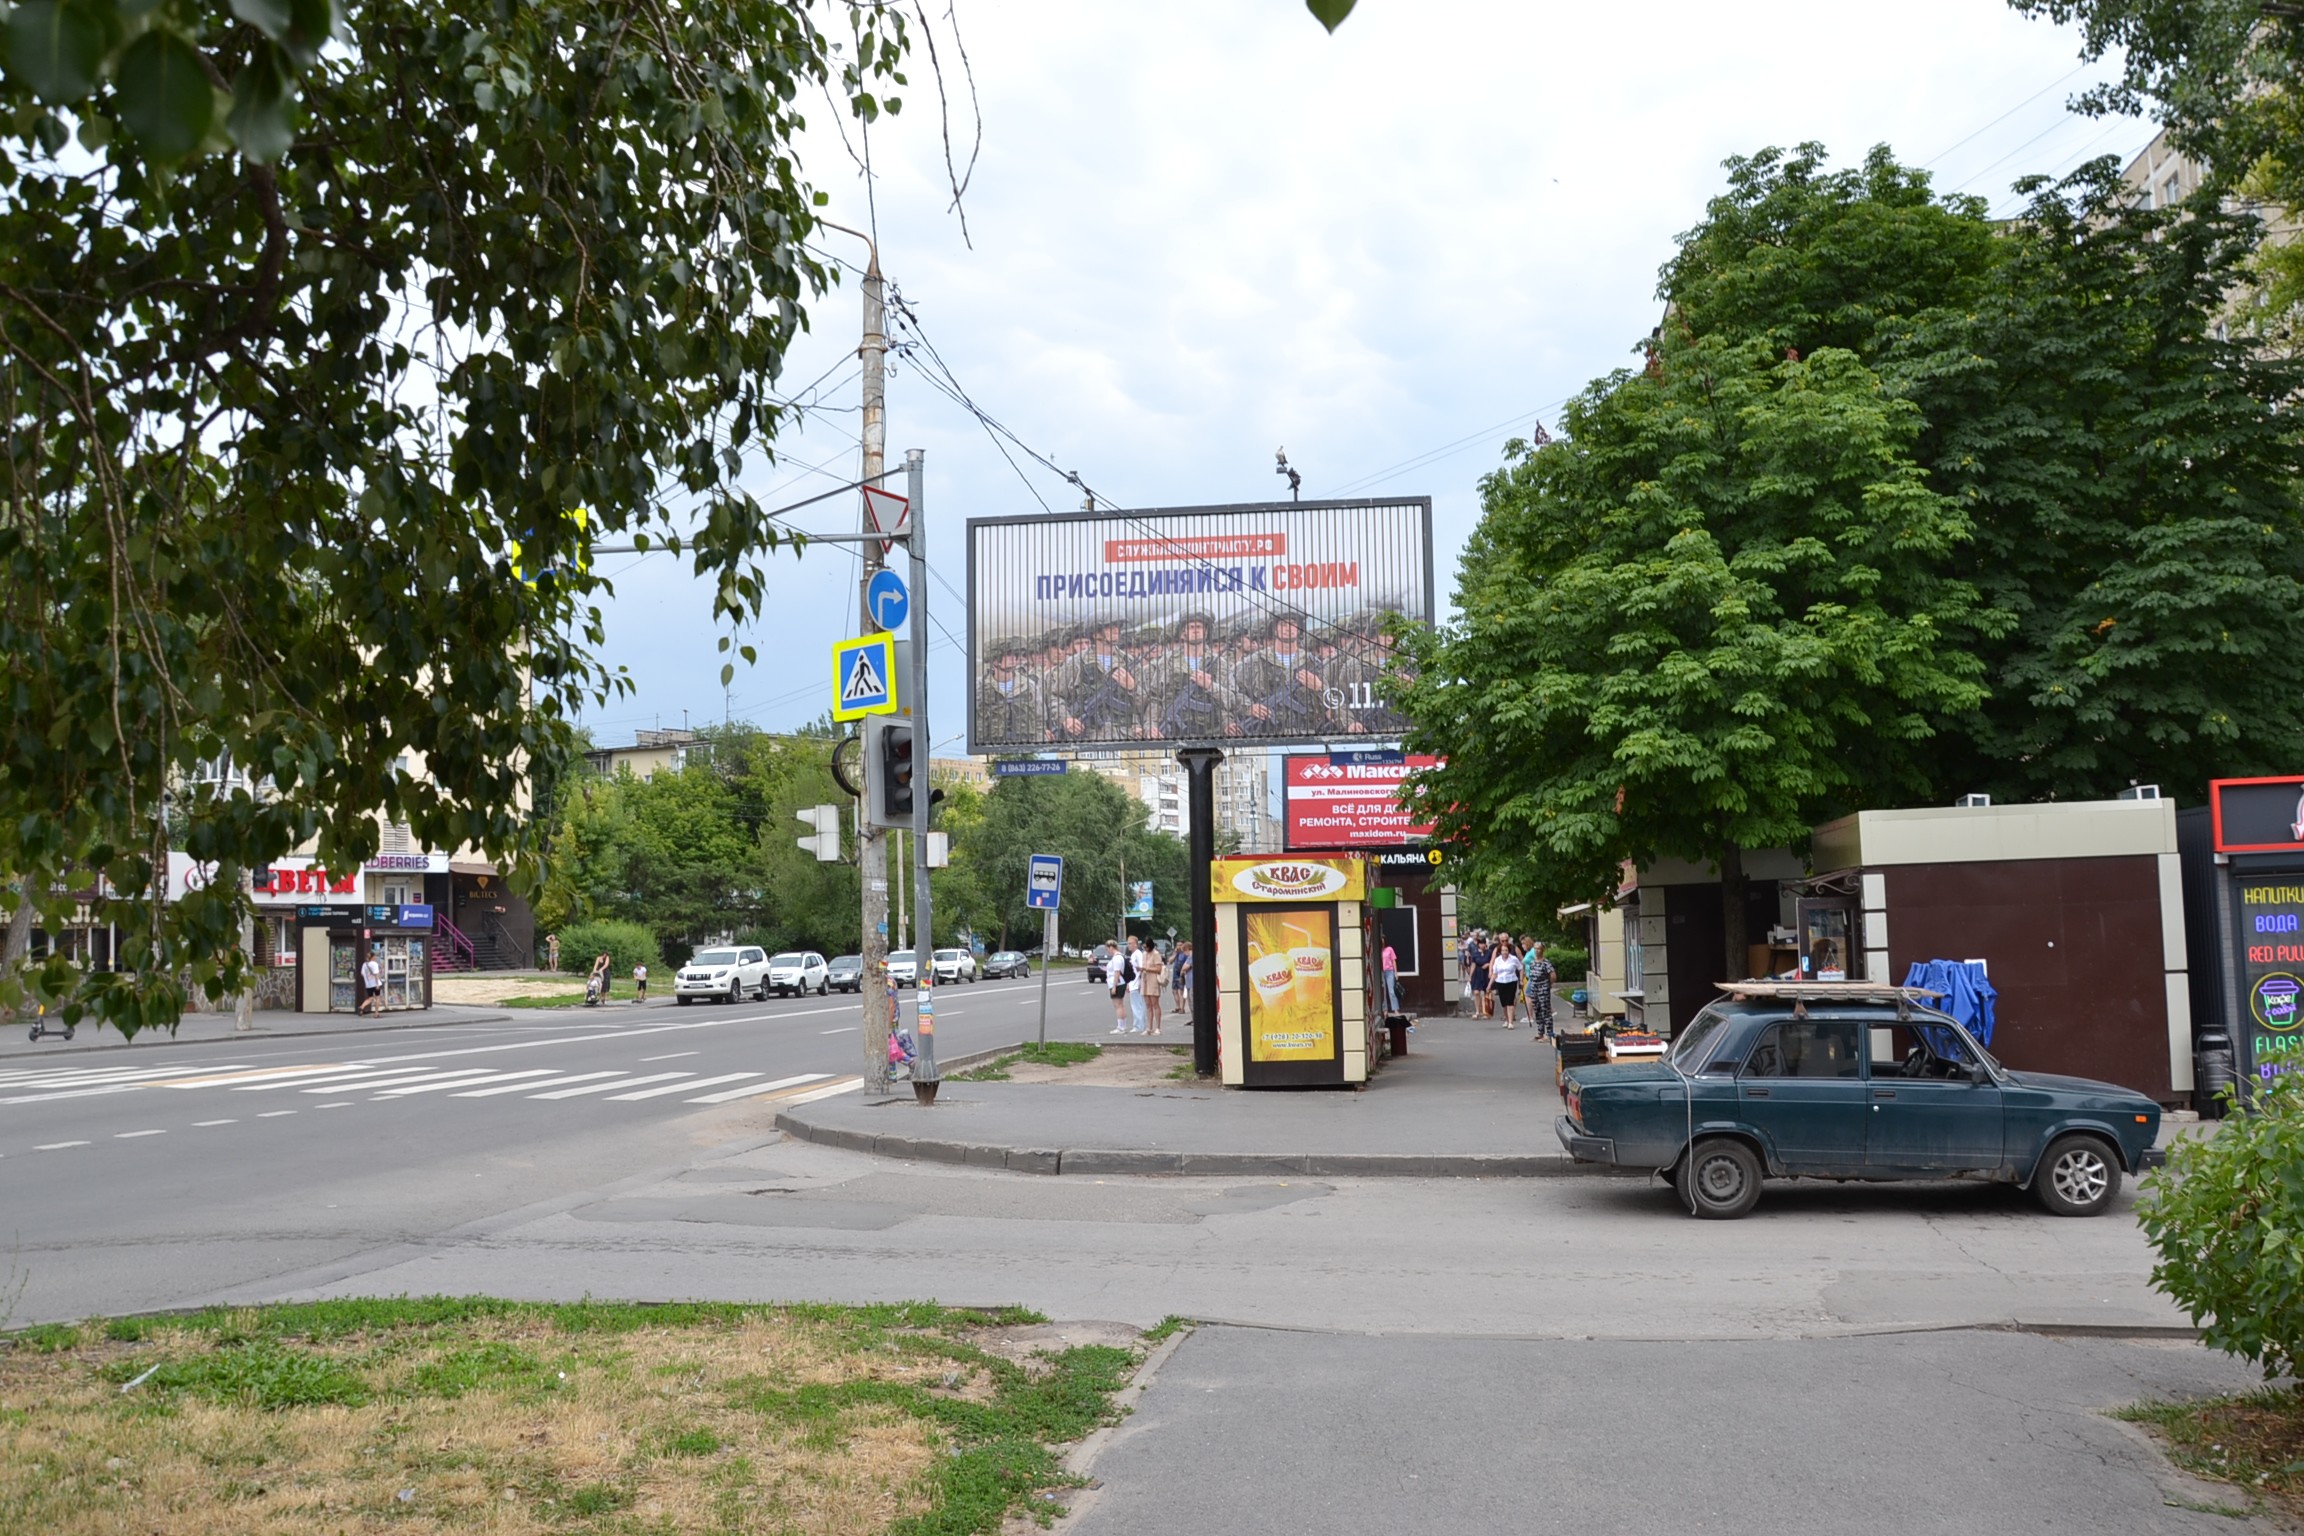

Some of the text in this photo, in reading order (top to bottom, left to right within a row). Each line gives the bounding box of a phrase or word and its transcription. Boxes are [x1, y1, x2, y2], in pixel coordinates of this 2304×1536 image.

[1117, 539, 1273, 558] СЛУЖБАПОКОНТРАКТУ.РФ
[1037, 562, 1358, 600] ПРИСОЕДИНЯЙСЯ К СВОИМ
[1349, 681, 1385, 709] 11
[1008, 763, 1026, 773] (863)
[1027, 763, 1061, 772] 226-77-26
[1311, 788, 1326, 797] ул.
[1332, 803, 1355, 815] ВСЁ
[1356, 805, 1382, 815] ДЛЯ
[1300, 817, 1357, 828] РЕМОНТА,
[1350, 830, 1407, 838] maxidom.ru
[1380, 853, 1426, 865] КАЛЬЯНА
[1269, 866, 1311, 882] КВАС
[1251, 880, 1327, 896] Староминский
[2255, 913, 2298, 933] ВОДА
[2248, 945, 2274, 963] RED
